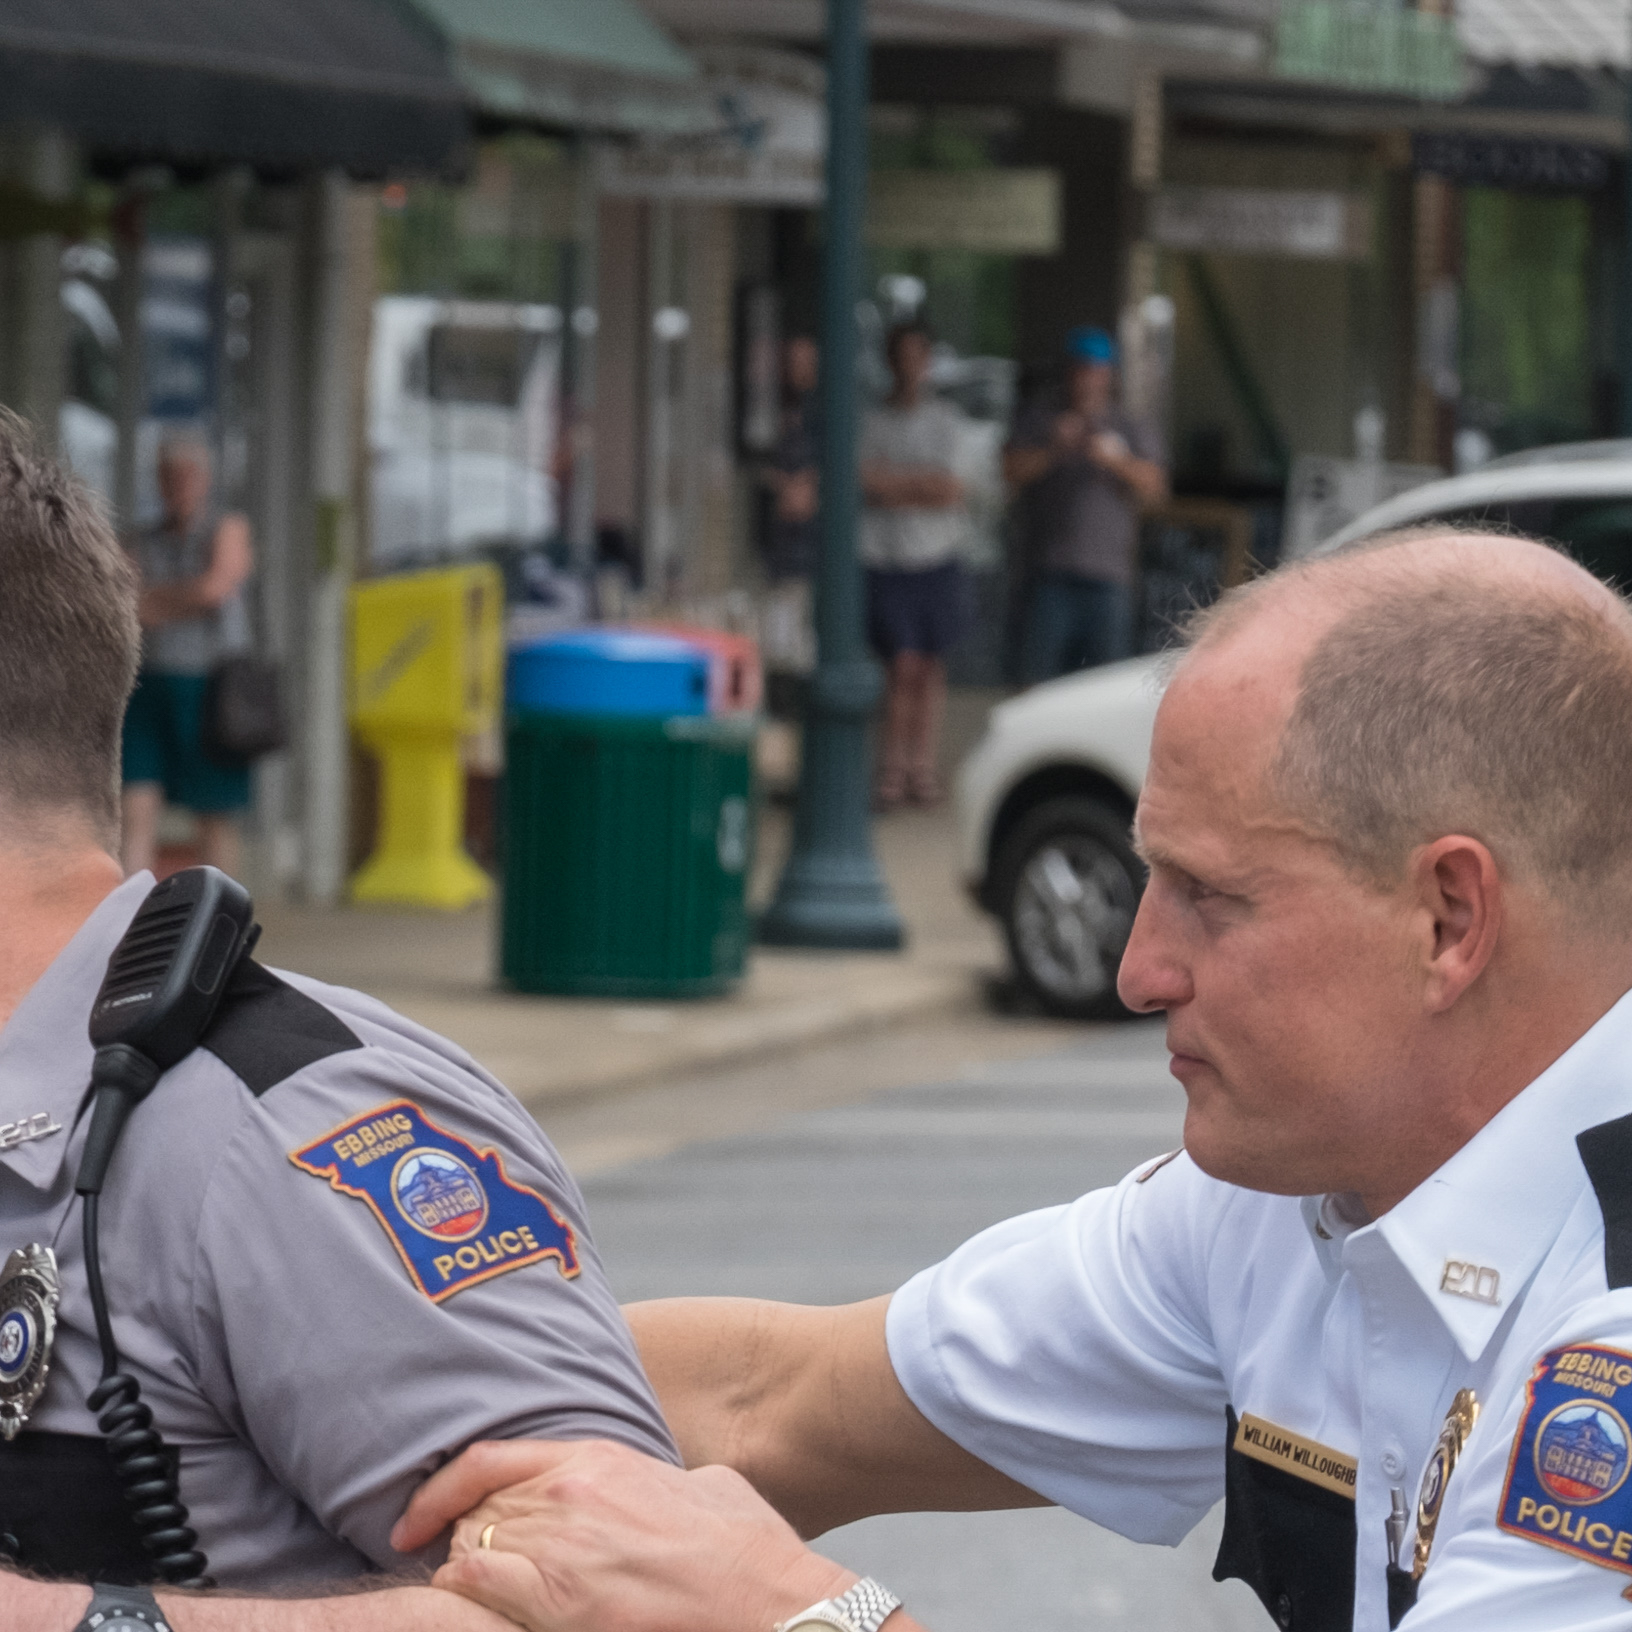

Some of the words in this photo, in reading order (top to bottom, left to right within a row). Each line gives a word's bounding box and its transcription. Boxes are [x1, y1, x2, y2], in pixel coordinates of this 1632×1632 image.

[333, 1113, 413, 1161] EBBING
[353, 1132, 415, 1168] MISSOURI
[433, 1226, 539, 1281] POLICE
[1553, 1371, 1617, 1398] MISSOURI
[1244, 1424, 1292, 1459] WILLIAM
